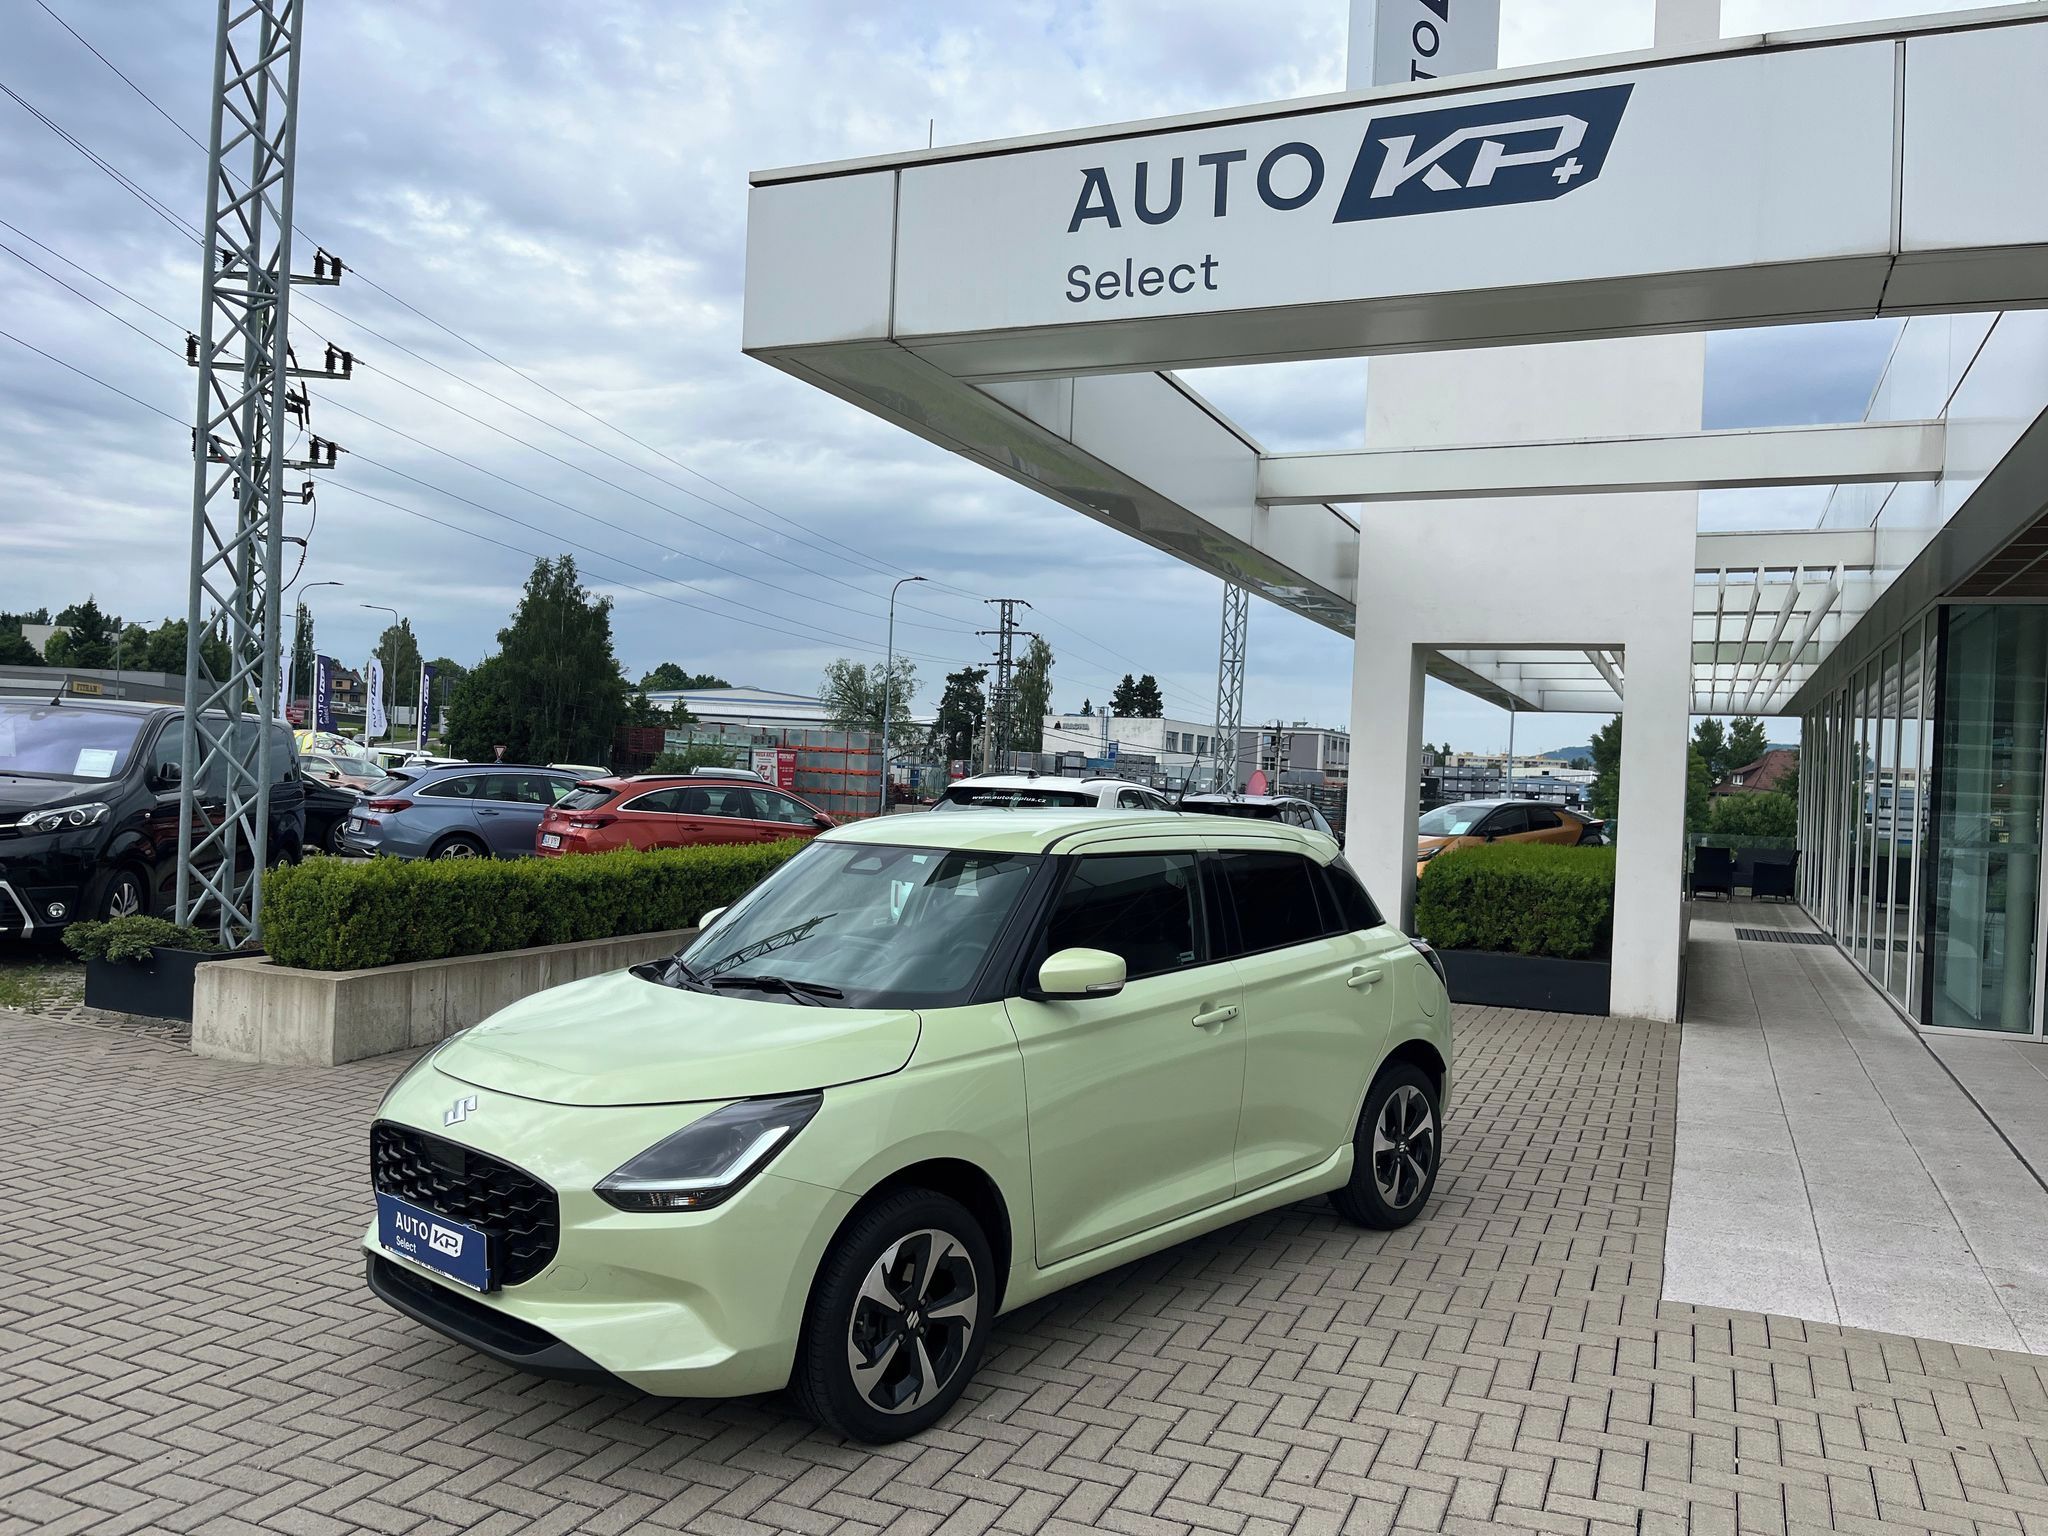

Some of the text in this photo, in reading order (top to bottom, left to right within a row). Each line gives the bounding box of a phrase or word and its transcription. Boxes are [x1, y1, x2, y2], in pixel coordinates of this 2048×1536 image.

[1410, 20, 1440, 82] TO
[1066, 141, 1325, 233] AUTO
[1065, 254, 1219, 302] Select
[395, 1211, 429, 1241] AUTO
[396, 1235, 417, 1254] Select
